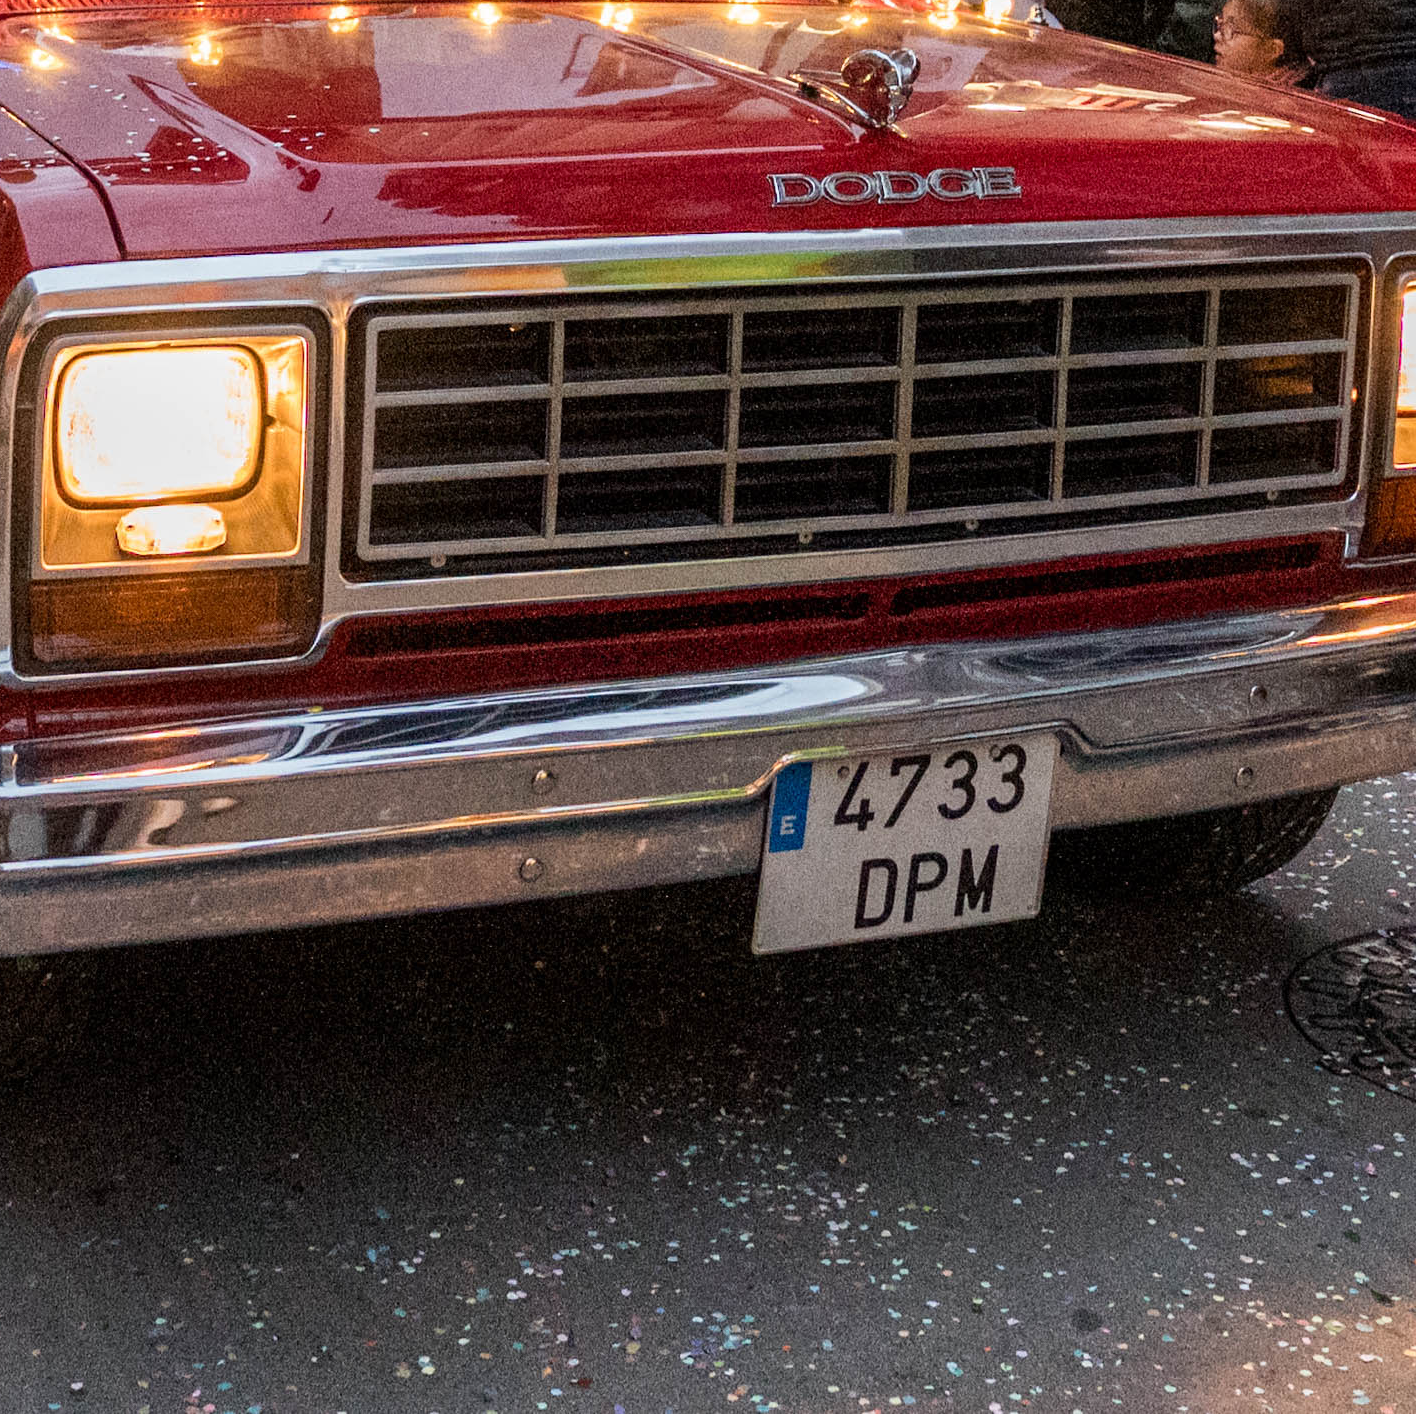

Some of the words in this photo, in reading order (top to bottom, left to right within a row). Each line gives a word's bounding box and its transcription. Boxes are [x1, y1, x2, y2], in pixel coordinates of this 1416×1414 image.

[766, 166, 1022, 208] DODGE
[834, 743, 1027, 832] 4733
[780, 815, 796, 836] E
[853, 845, 999, 929] DPM
